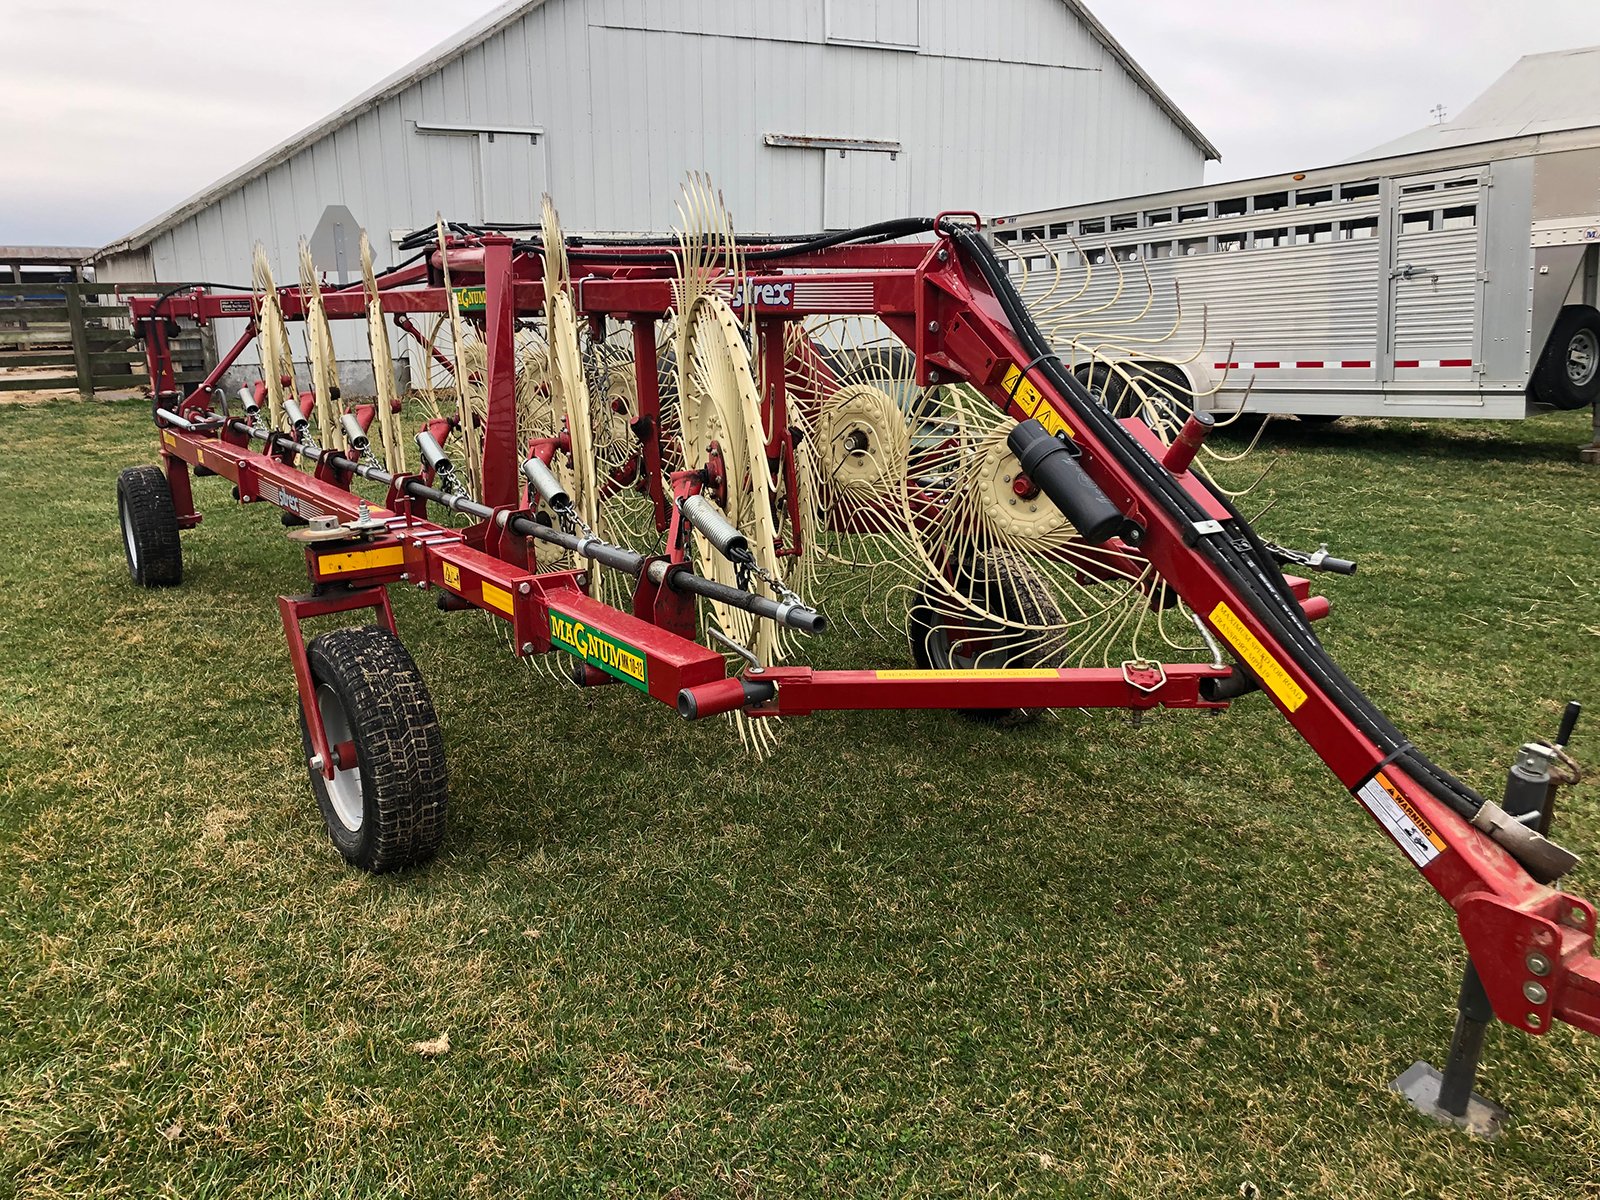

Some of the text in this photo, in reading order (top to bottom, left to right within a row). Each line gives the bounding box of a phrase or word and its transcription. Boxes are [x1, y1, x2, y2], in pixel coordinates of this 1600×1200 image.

[457, 288, 487, 308] AGNUM
[550, 615, 621, 669] MAGNUM
[1213, 614, 1249, 653] TRANSPORT
[1219, 606, 1303, 701] MAXIMUM SPEED FOR ROAD
[1395, 795, 1433, 837] WARNING
